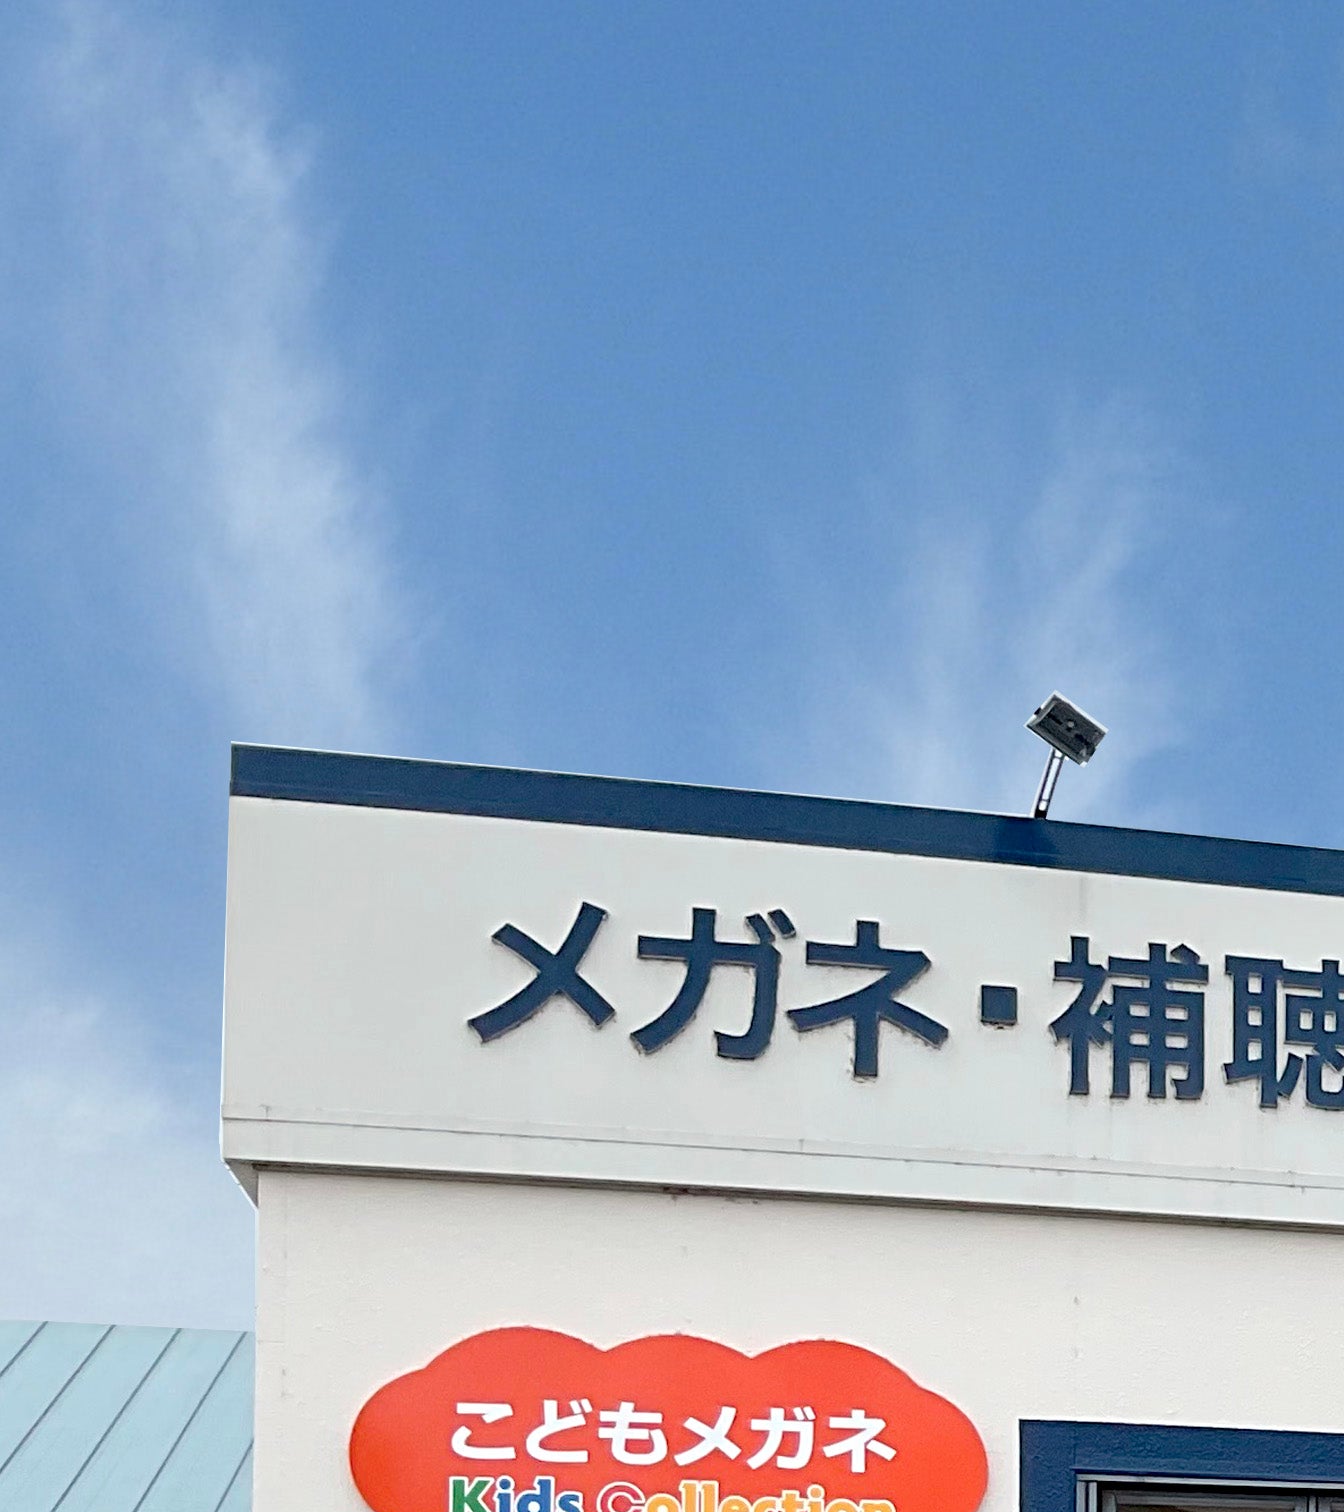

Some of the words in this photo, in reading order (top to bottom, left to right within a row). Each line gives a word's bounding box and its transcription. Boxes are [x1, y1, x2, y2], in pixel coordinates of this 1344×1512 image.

[450, 1398, 897, 1474] こどもメガネ
